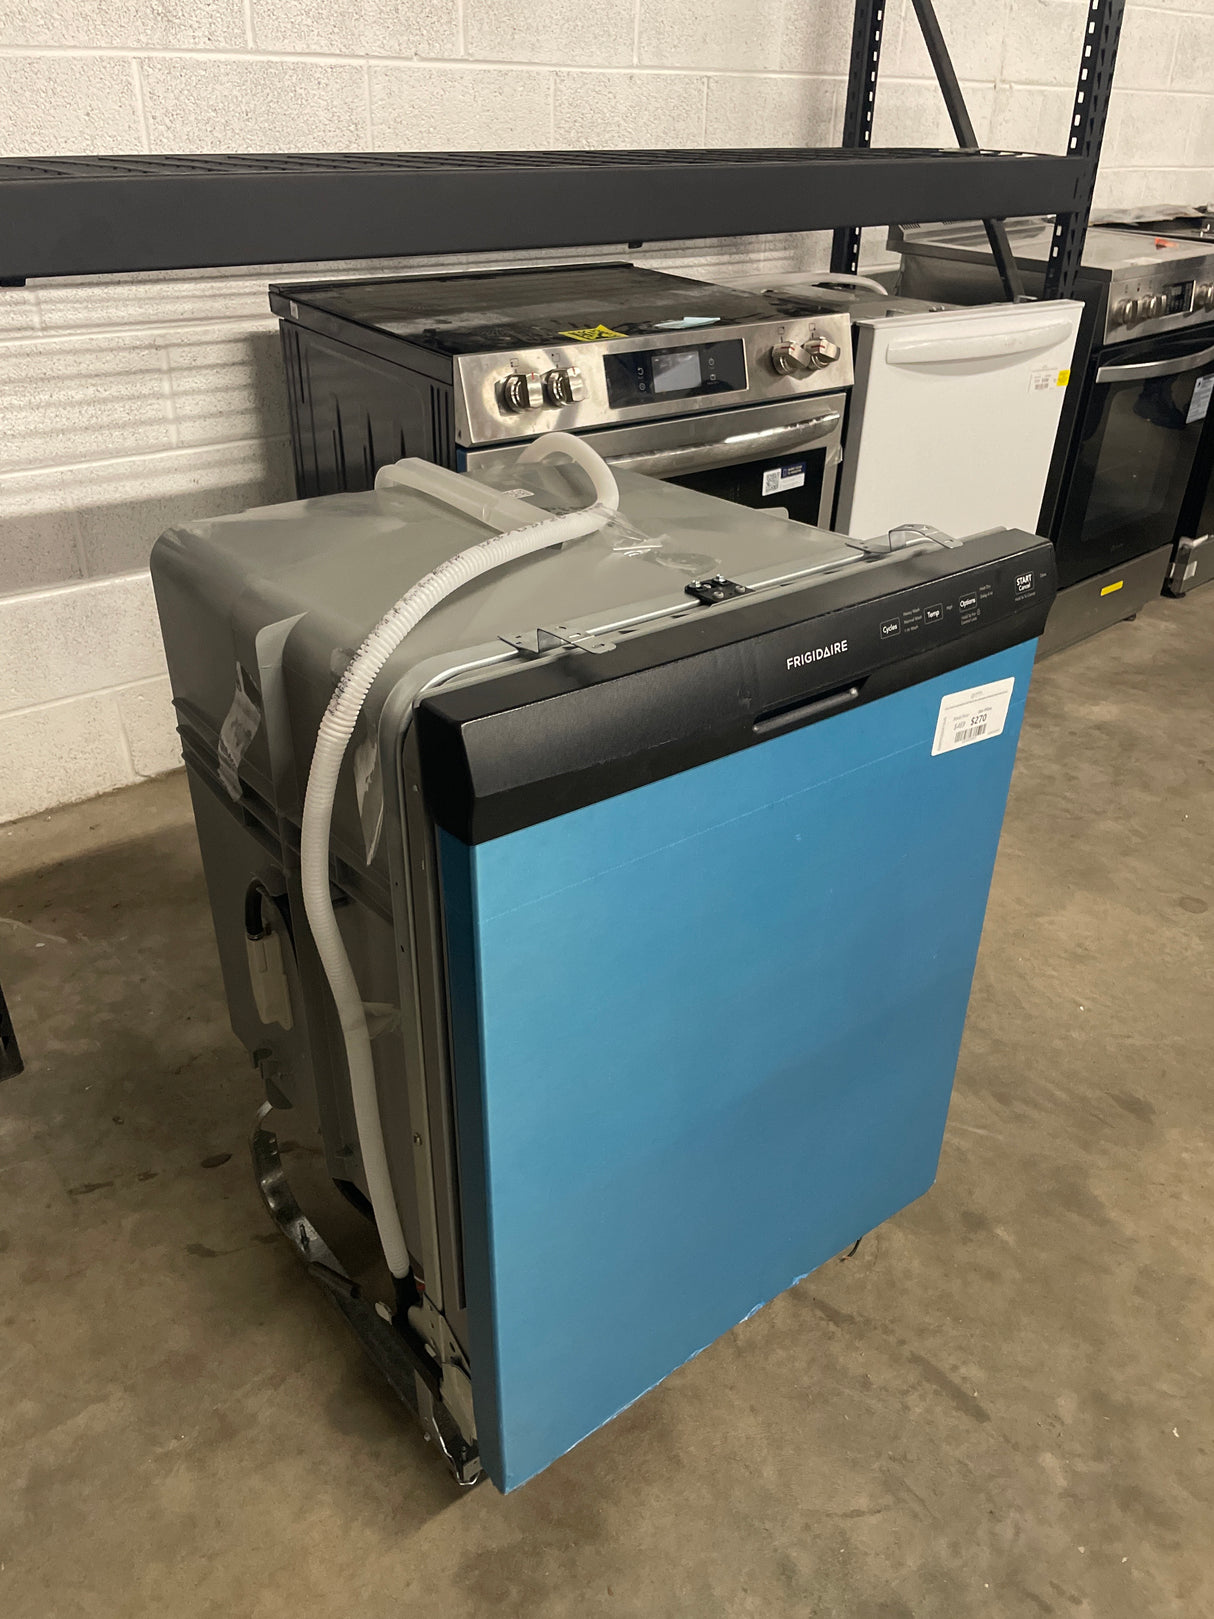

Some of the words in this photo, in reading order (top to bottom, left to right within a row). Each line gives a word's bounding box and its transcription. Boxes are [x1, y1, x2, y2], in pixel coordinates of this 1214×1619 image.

[1016, 574, 1032, 587] START
[1018, 582, 1031, 591] Cancel
[960, 598, 976, 608] Options
[927, 610, 940, 618] Temp
[882, 623, 898, 634] Cycles
[786, 639, 848, 670] FRIGIDAIRE
[970, 713, 987, 726] $270
